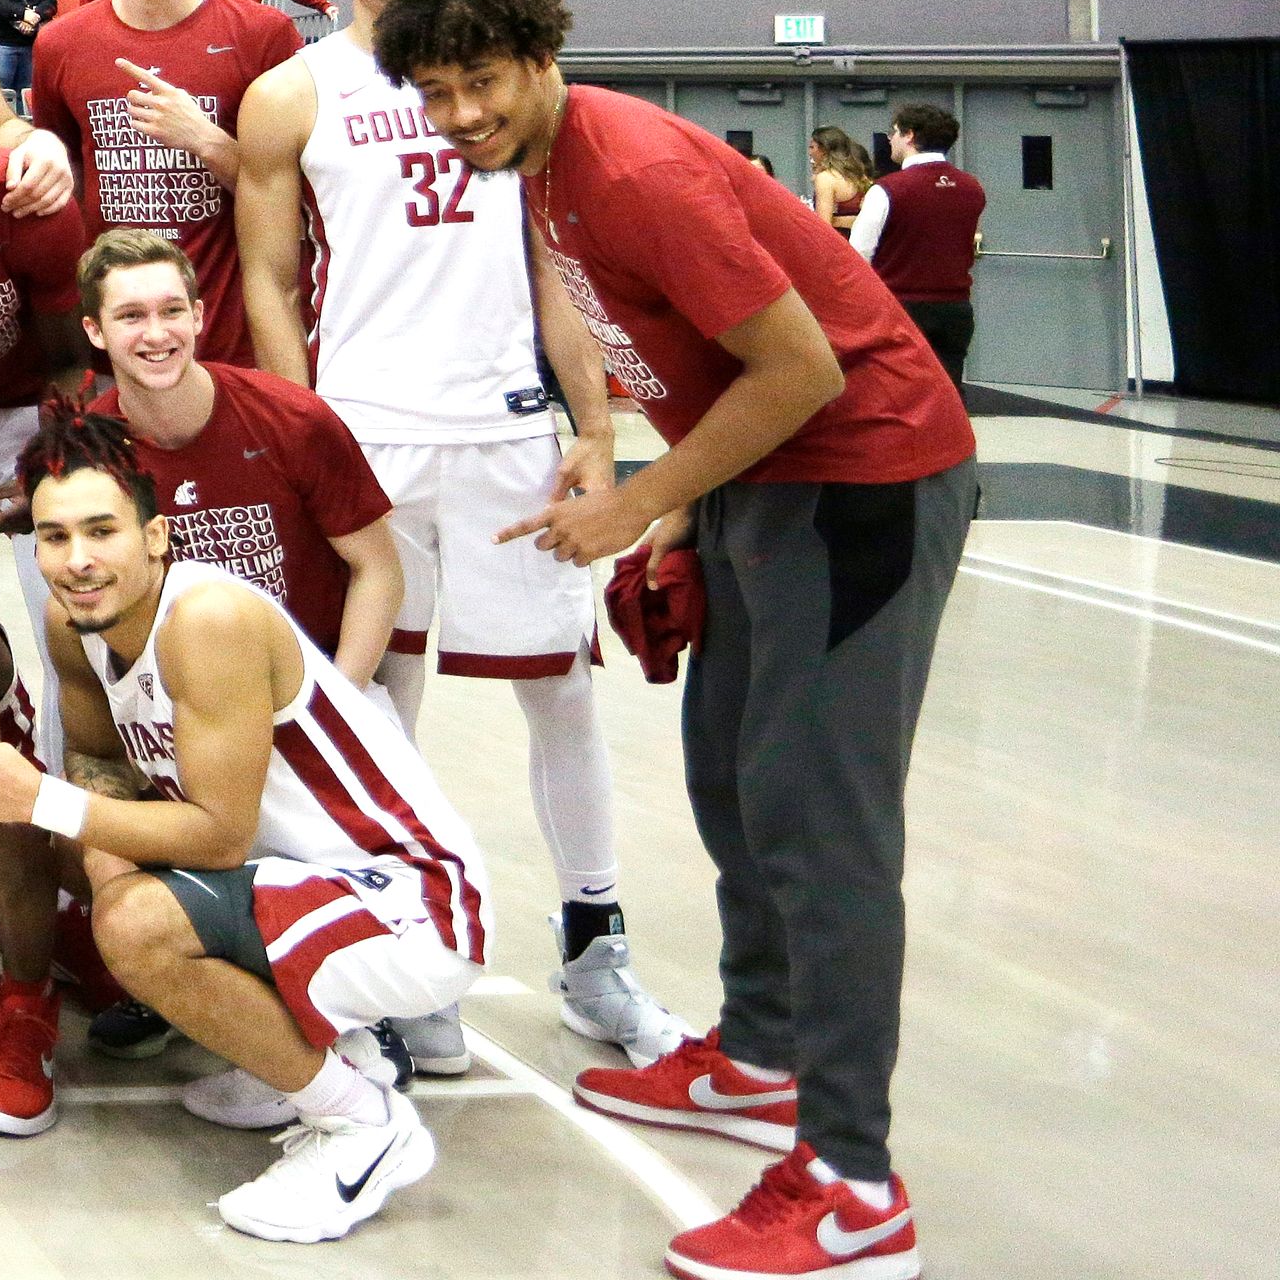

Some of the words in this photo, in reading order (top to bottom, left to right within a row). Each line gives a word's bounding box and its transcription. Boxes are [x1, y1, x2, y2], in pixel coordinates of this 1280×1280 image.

[784, 17, 816, 38] EXIT
[87, 97, 132, 117] THA
[90, 115, 133, 132] THA
[95, 148, 140, 170] COACH
[99, 173, 168, 190] THANK
[169, 171, 218, 190] YOU
[395, 148, 474, 227] 32
[100, 189, 170, 206] THANK
[171, 186, 221, 206] YOU
[102, 205, 171, 222] THANK
[171, 199, 221, 222] YOU
[208, 503, 272, 524] YOU
[213, 519, 274, 542] YOU
[217, 533, 277, 558] YOU
